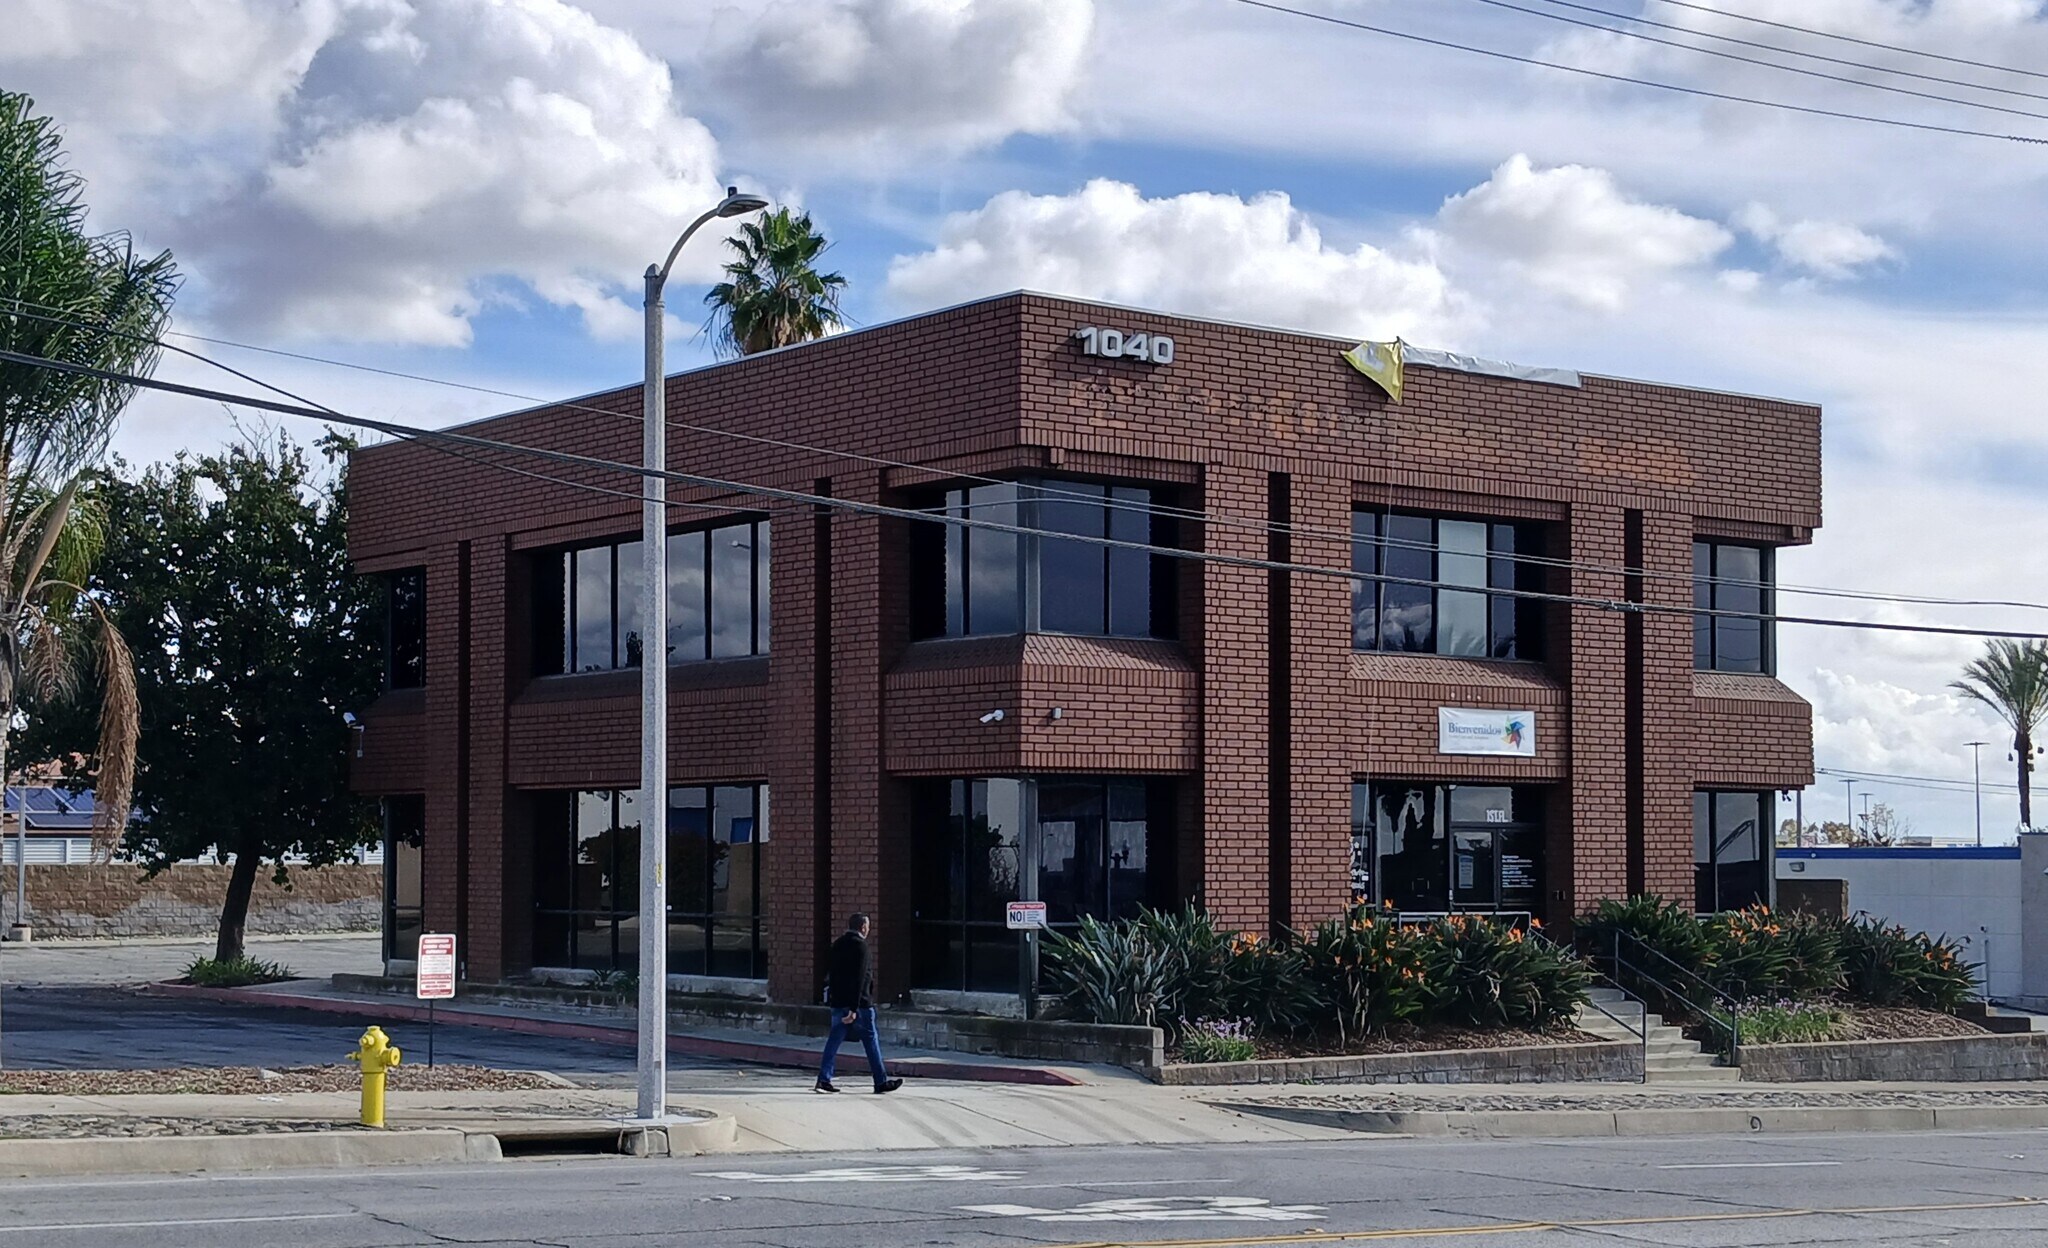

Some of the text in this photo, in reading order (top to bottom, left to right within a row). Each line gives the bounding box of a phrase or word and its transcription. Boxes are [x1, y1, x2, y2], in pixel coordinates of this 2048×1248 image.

[1076, 327, 1174, 364] 1040
[1448, 722, 1502, 735] Bienvenidos
[1009, 911, 1022, 922] NO
